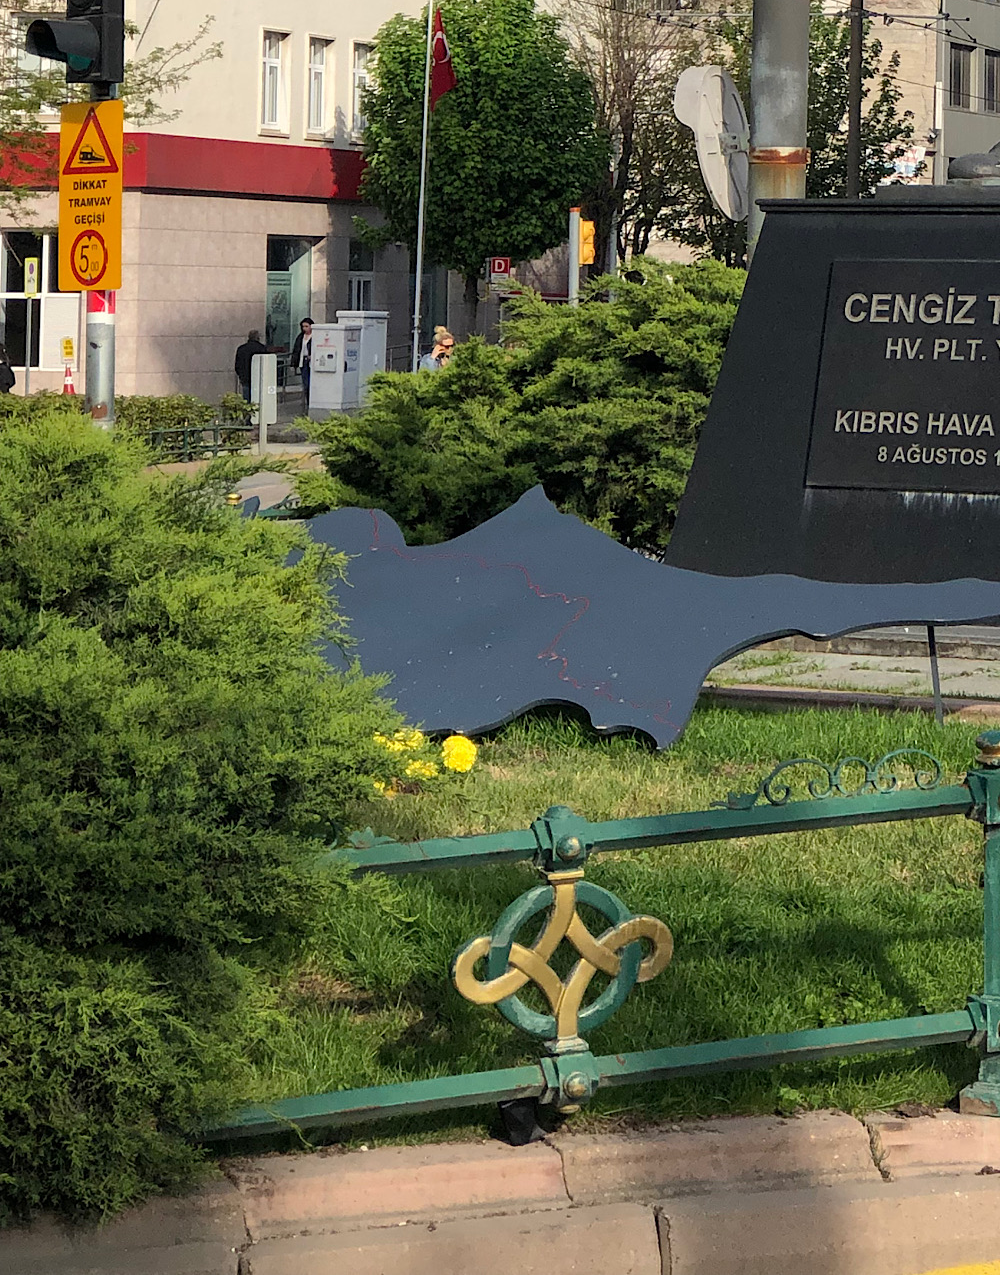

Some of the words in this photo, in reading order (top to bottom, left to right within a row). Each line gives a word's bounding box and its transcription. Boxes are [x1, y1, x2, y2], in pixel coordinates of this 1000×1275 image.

[73, 179, 107, 191] DİKKAT
[68, 196, 112, 208] TRAMVAY
[74, 212, 105, 226] GEÇİŞİ
[844, 287, 977, 325] CENGİZ
[885, 337, 924, 360] HV.
[933, 338, 987, 361] PLT.
[834, 409, 919, 435] KIBRIS
[926, 412, 995, 437] HAVA
[877, 445, 888, 463] 8
[891, 443, 987, 467] AĞUSTOS
